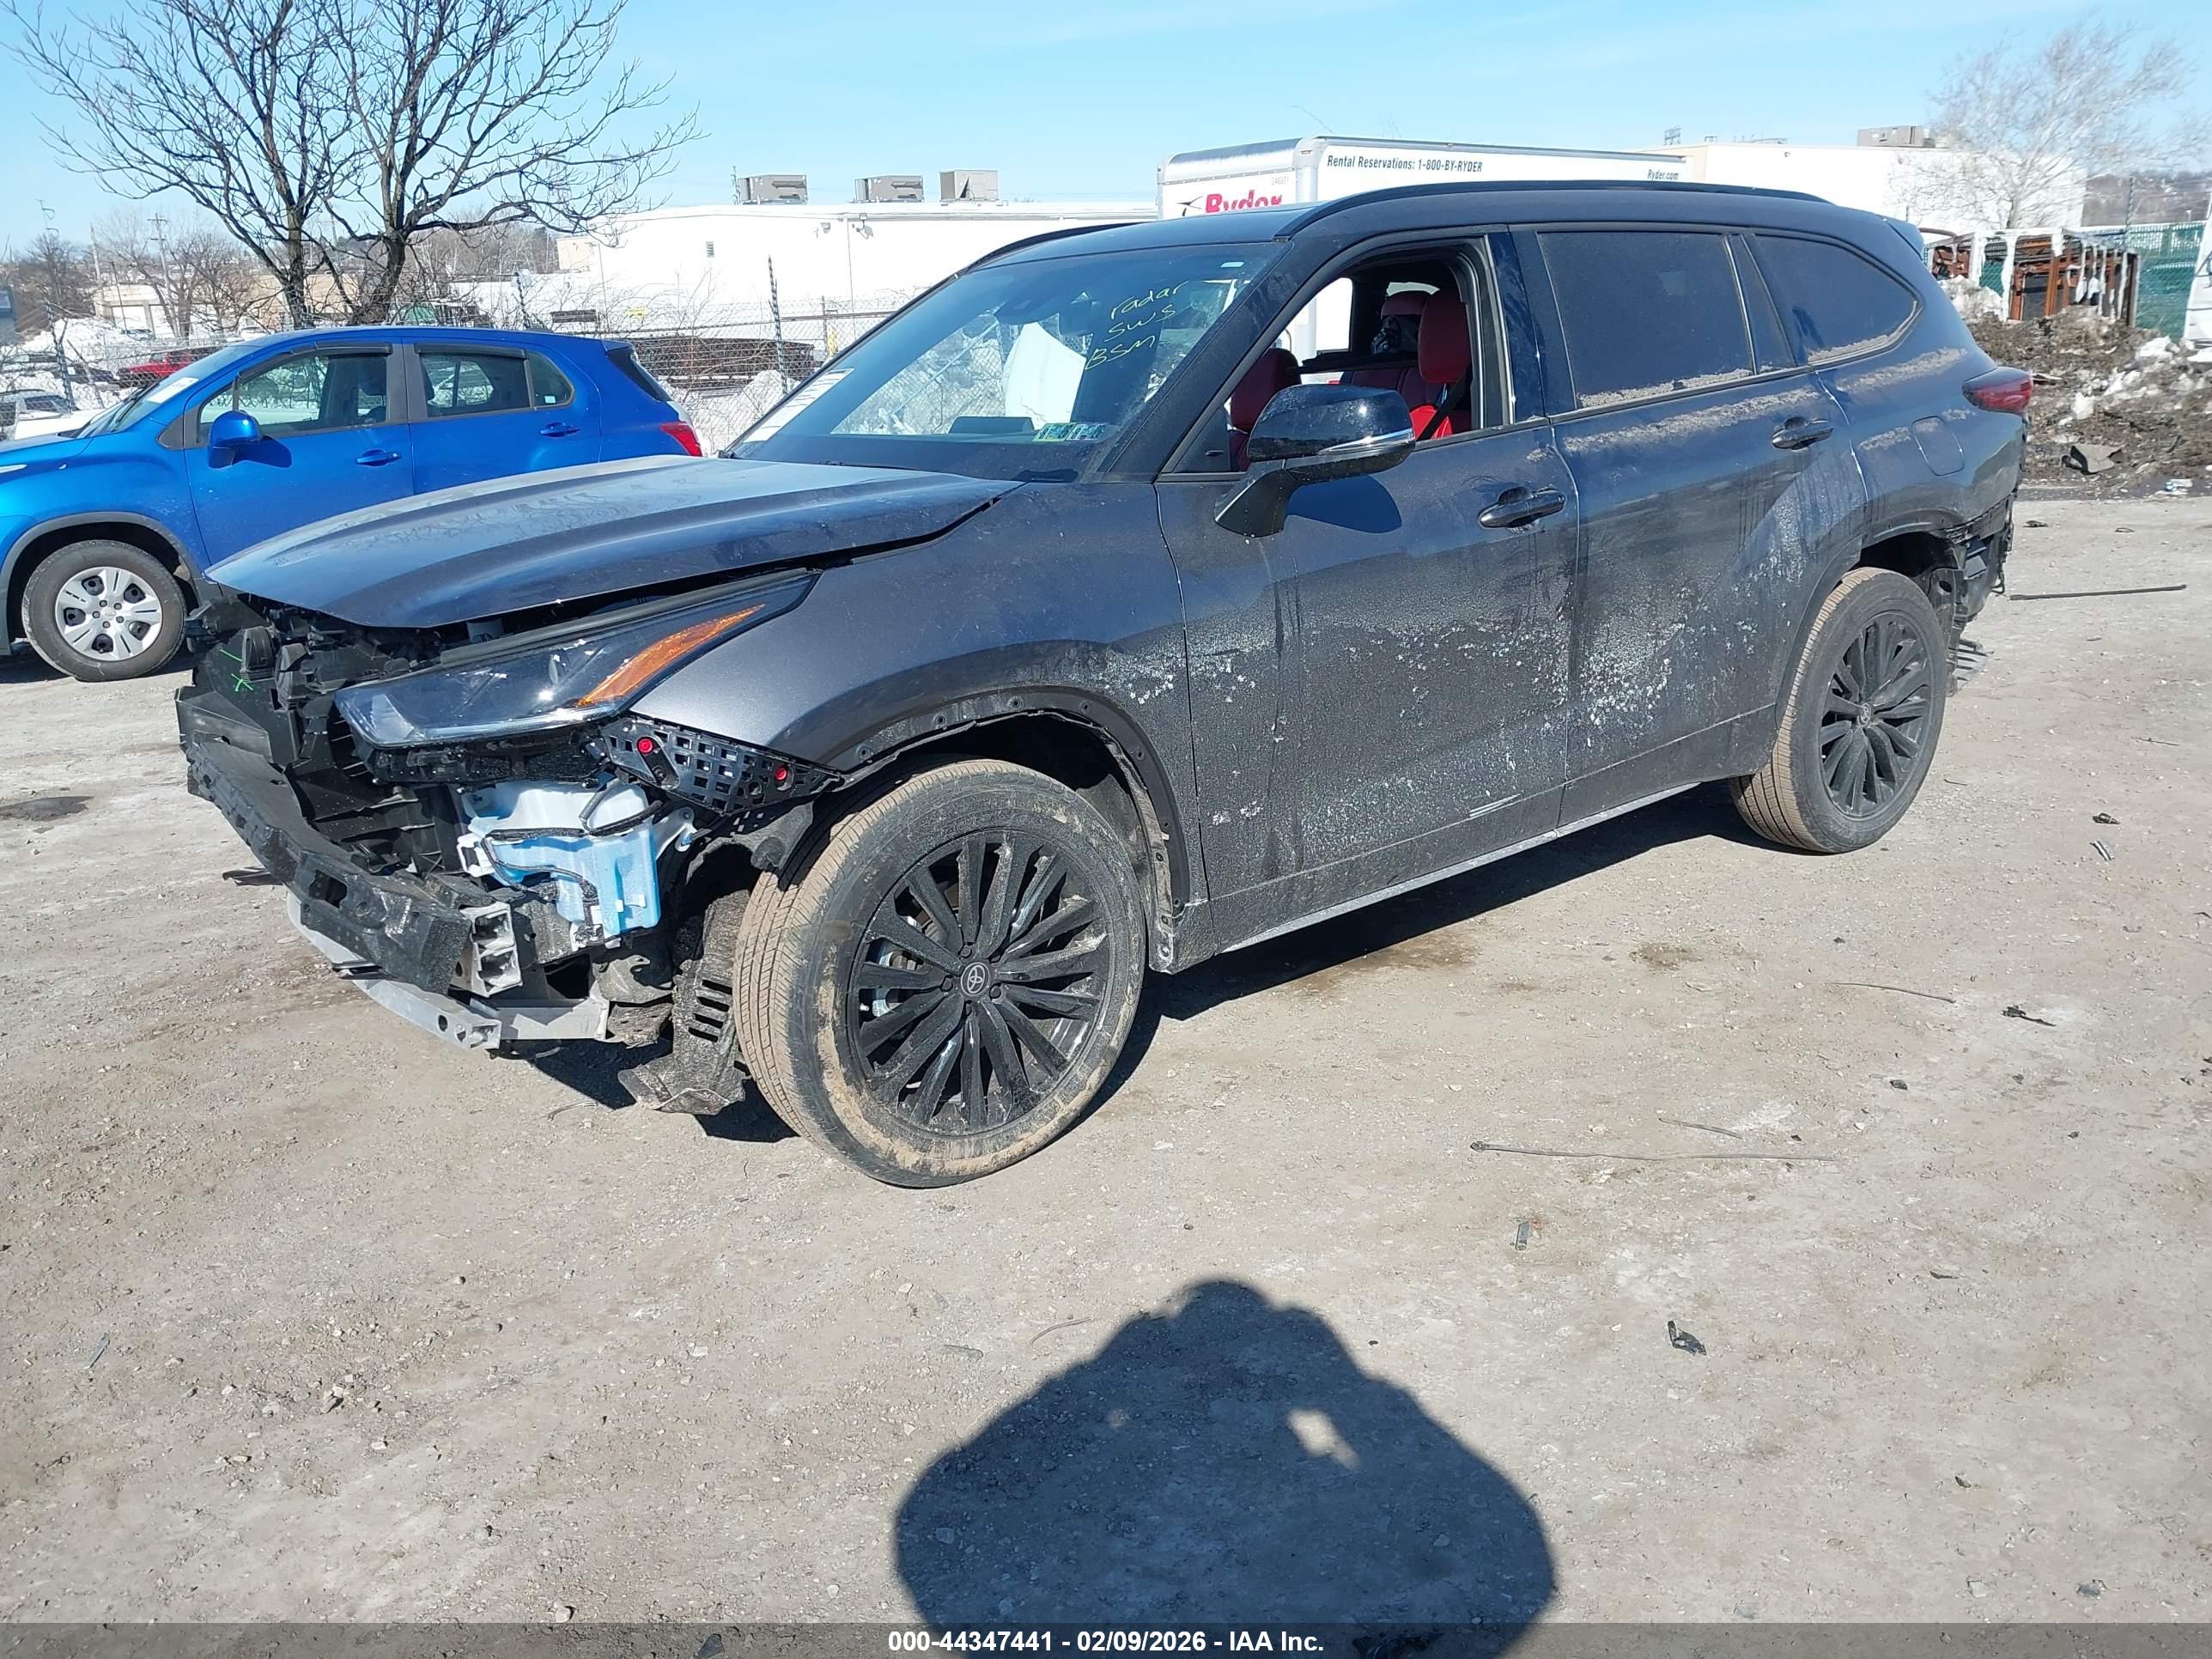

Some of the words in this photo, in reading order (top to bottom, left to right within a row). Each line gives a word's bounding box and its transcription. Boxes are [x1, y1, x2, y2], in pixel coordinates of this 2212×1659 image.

[1327, 155, 1356, 167] Rental
[1358, 156, 1415, 170] Reservations:
[1418, 159, 1483, 173] 1-800-BY-RYDER
[1647, 168, 1679, 181] Ryder.com
[1110, 280, 1188, 319] radar
